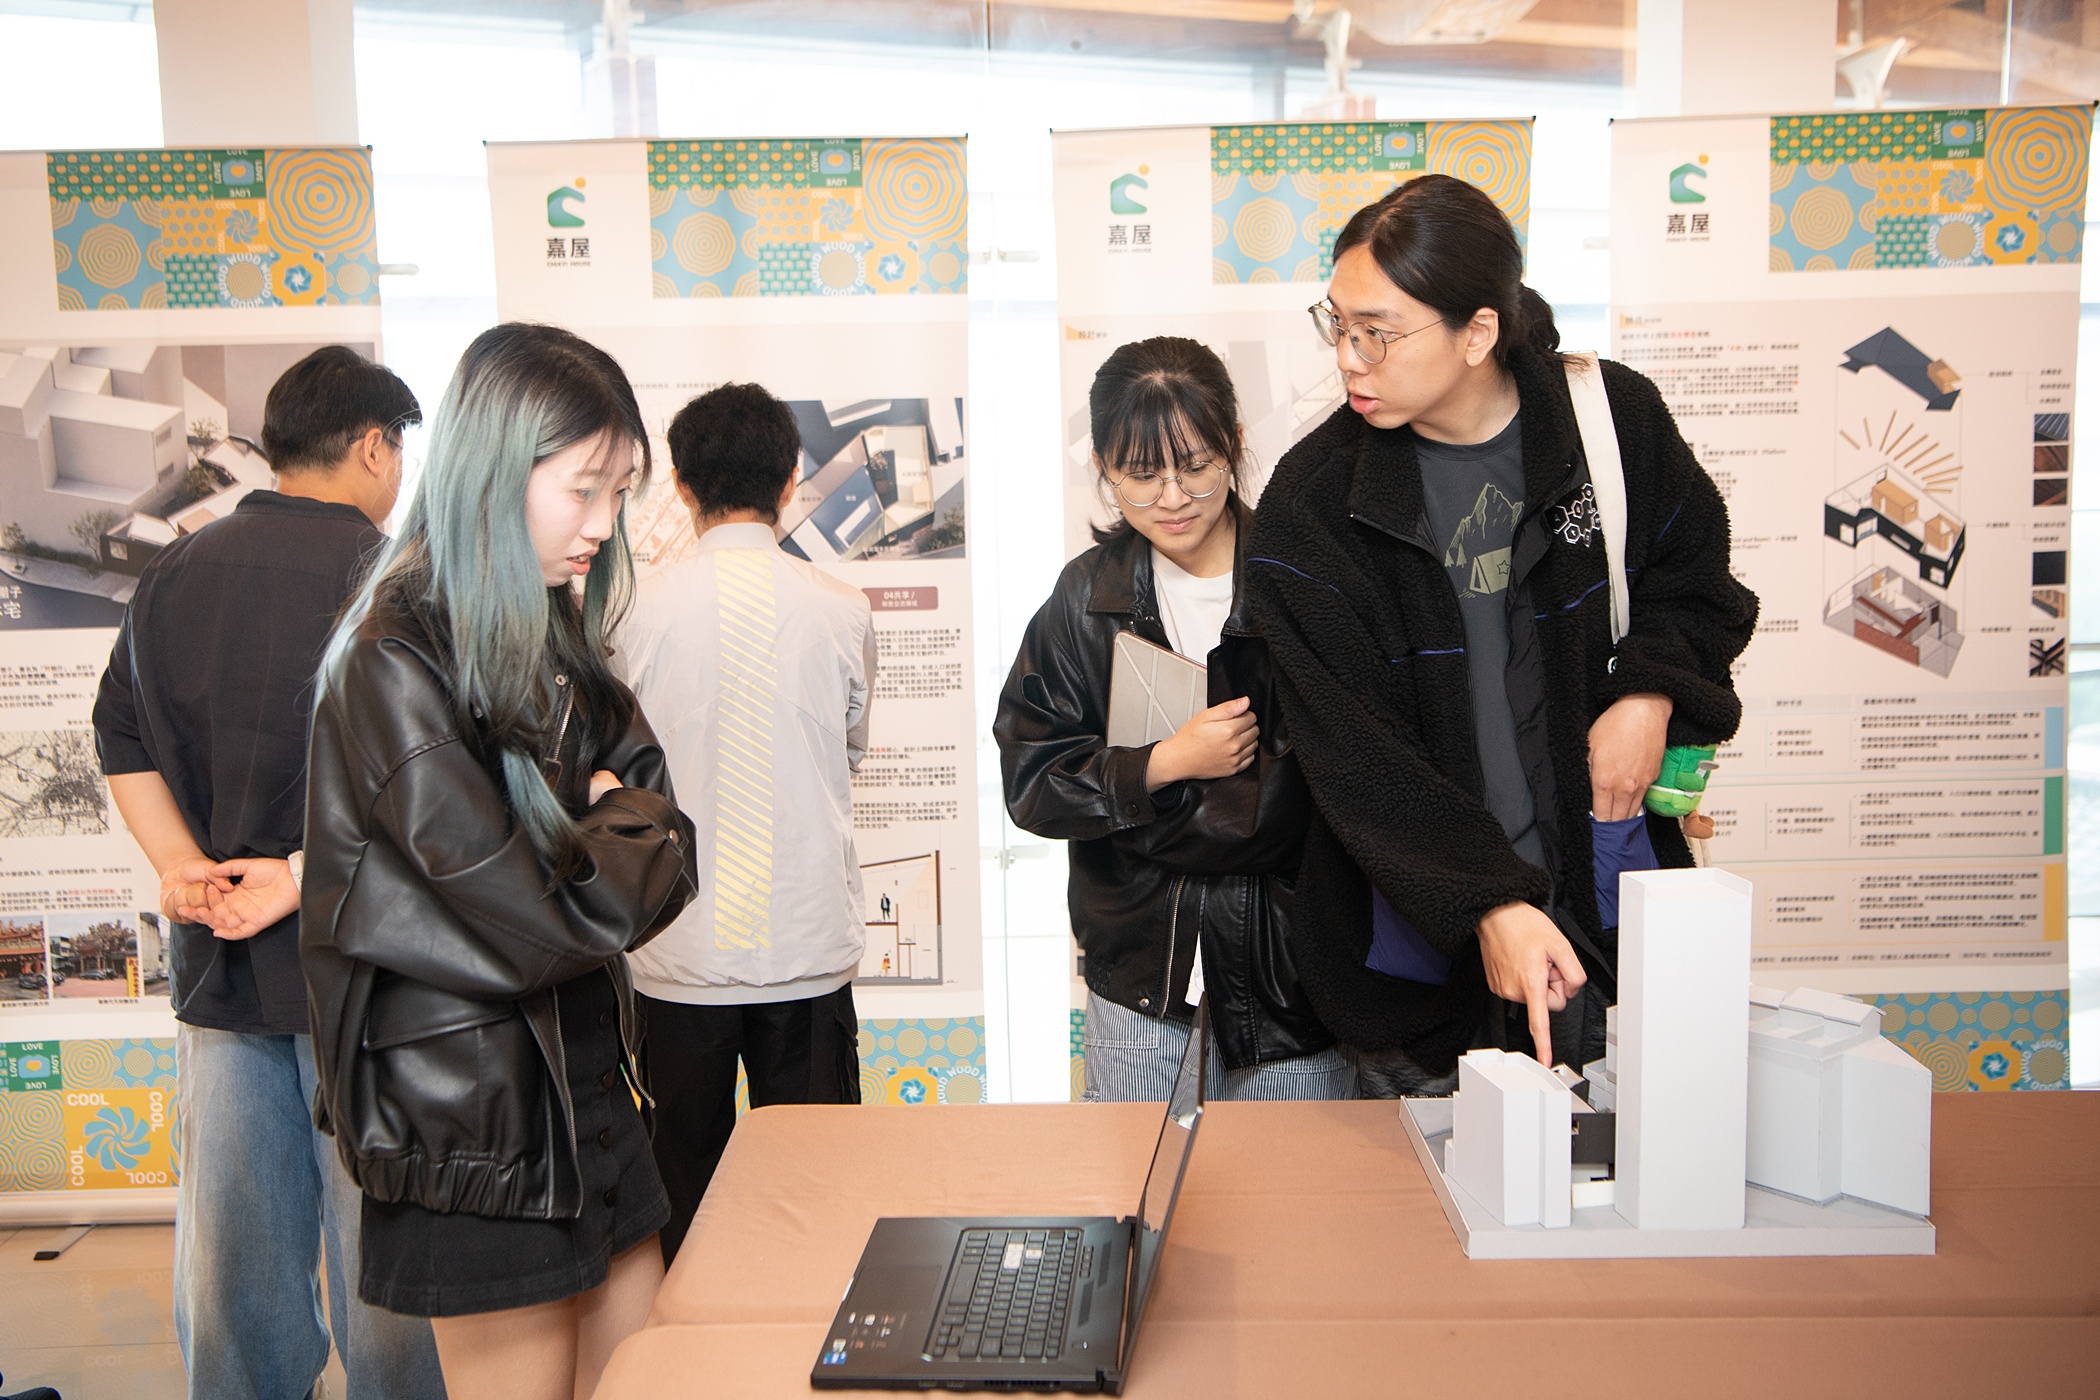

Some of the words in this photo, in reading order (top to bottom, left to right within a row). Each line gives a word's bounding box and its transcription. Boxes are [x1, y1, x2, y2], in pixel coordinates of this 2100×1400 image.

[1667, 214, 1710, 235] 嘉屋
[1938, 213, 1975, 225] WOOD
[1108, 225, 1151, 245] 嘉屋
[1927, 225, 1940, 260] WOOD
[1972, 221, 1984, 258] WOOD
[547, 238, 590, 258] 嘉屋
[821, 242, 855, 253] WOOD
[227, 253, 261, 266] WOOD
[854, 252, 866, 287] WOOD
[1938, 257, 1974, 268] WOOD
[261, 261, 272, 298] WOOD
[810, 253, 823, 289] WOOD
[218, 264, 230, 300] WOOD
[823, 284, 857, 296] WOOD
[230, 297, 264, 308] WOOD
[0, 601, 21, 618] 宅
[2031, 1040, 2064, 1051] WOOD
[51, 1055, 60, 1075] LOVE
[946, 1066, 980, 1077] WOOD
[2022, 1050, 2032, 1083] WOOD
[25, 1081, 47, 1090] LOVE
[66, 1093, 110, 1106] COOL
[148, 1091, 164, 1132] COOL
[70, 1145, 85, 1187] COOL
[125, 1171, 167, 1185] COOL
